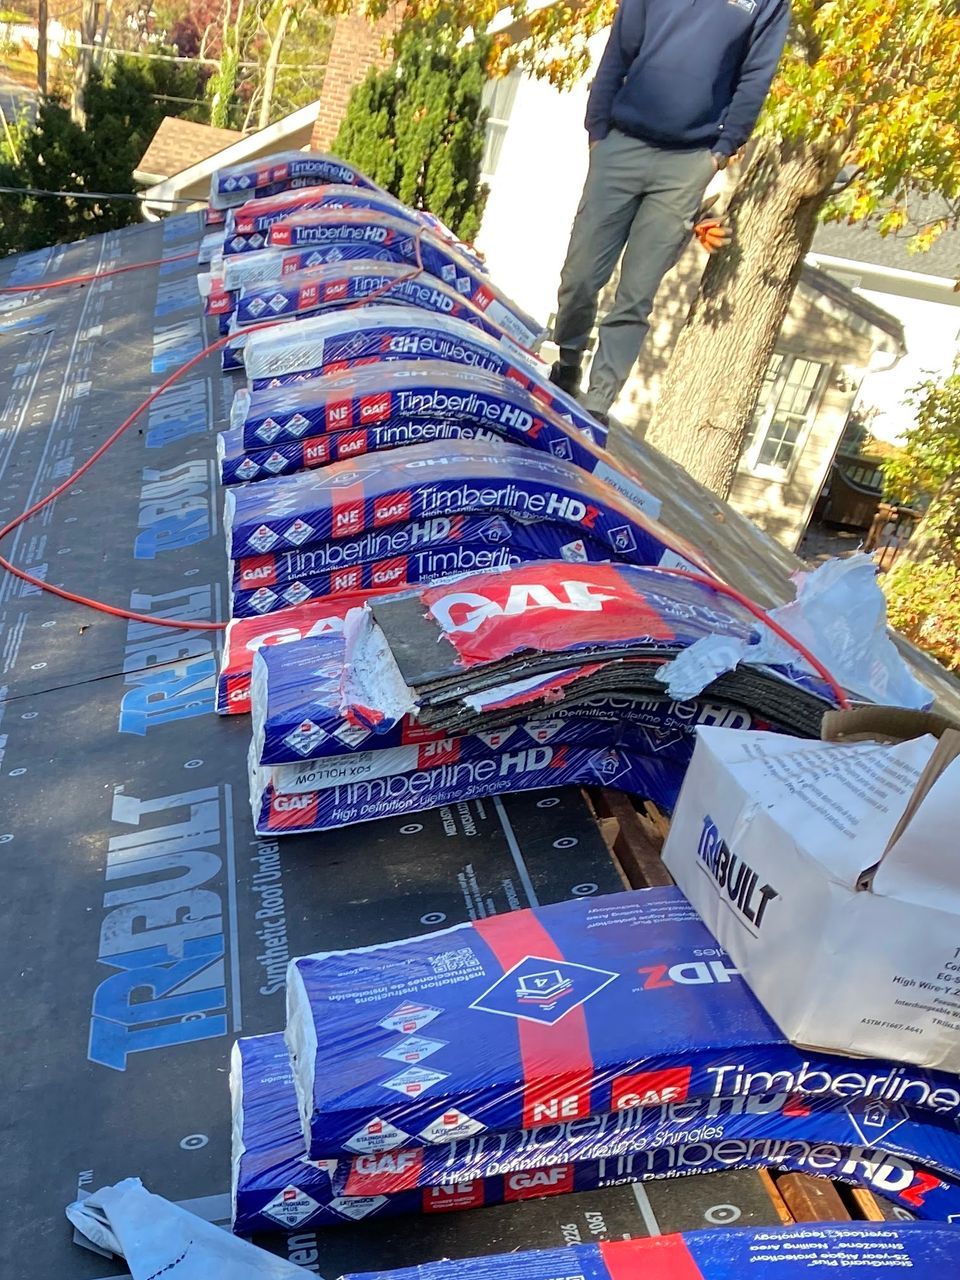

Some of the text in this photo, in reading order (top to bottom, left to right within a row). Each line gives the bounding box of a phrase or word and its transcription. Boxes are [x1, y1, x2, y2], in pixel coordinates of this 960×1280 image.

[295, 226, 364, 242] Timberline
[329, 408, 349, 422] NE
[362, 402, 389, 417] GAF
[397, 390, 502, 421] Timberline
[307, 446, 326, 458] NE
[339, 439, 366, 453] GAF
[372, 419, 474, 444] Timberline
[337, 484, 602, 529] NE GAF Timberline HDZ
[242, 565, 273, 581] GAF
[282, 530, 409, 573] Timberline
[334, 566, 405, 589] NE GAF
[430, 580, 617, 633] GAF
[295, 764, 372, 786] FOX HOLLOW
[273, 794, 314, 813] GAF
[331, 805, 360, 823] High
[698, 816, 780, 930] TRIBUILT
[87, 785, 230, 1072] TRIBUILT
[251, 882, 290, 996] Synthetic Roof
[355, 970, 486, 1004] Installation instructions
[407, 966, 484, 987] Instrucciones
[892, 975, 916, 987] High
[533, 1061, 960, 1121] NE GAF Timberline
[355, 1149, 417, 1176] GAF
[509, 1149, 940, 1207] GAF HDZ
[584, 1211, 608, 1235] 1067
